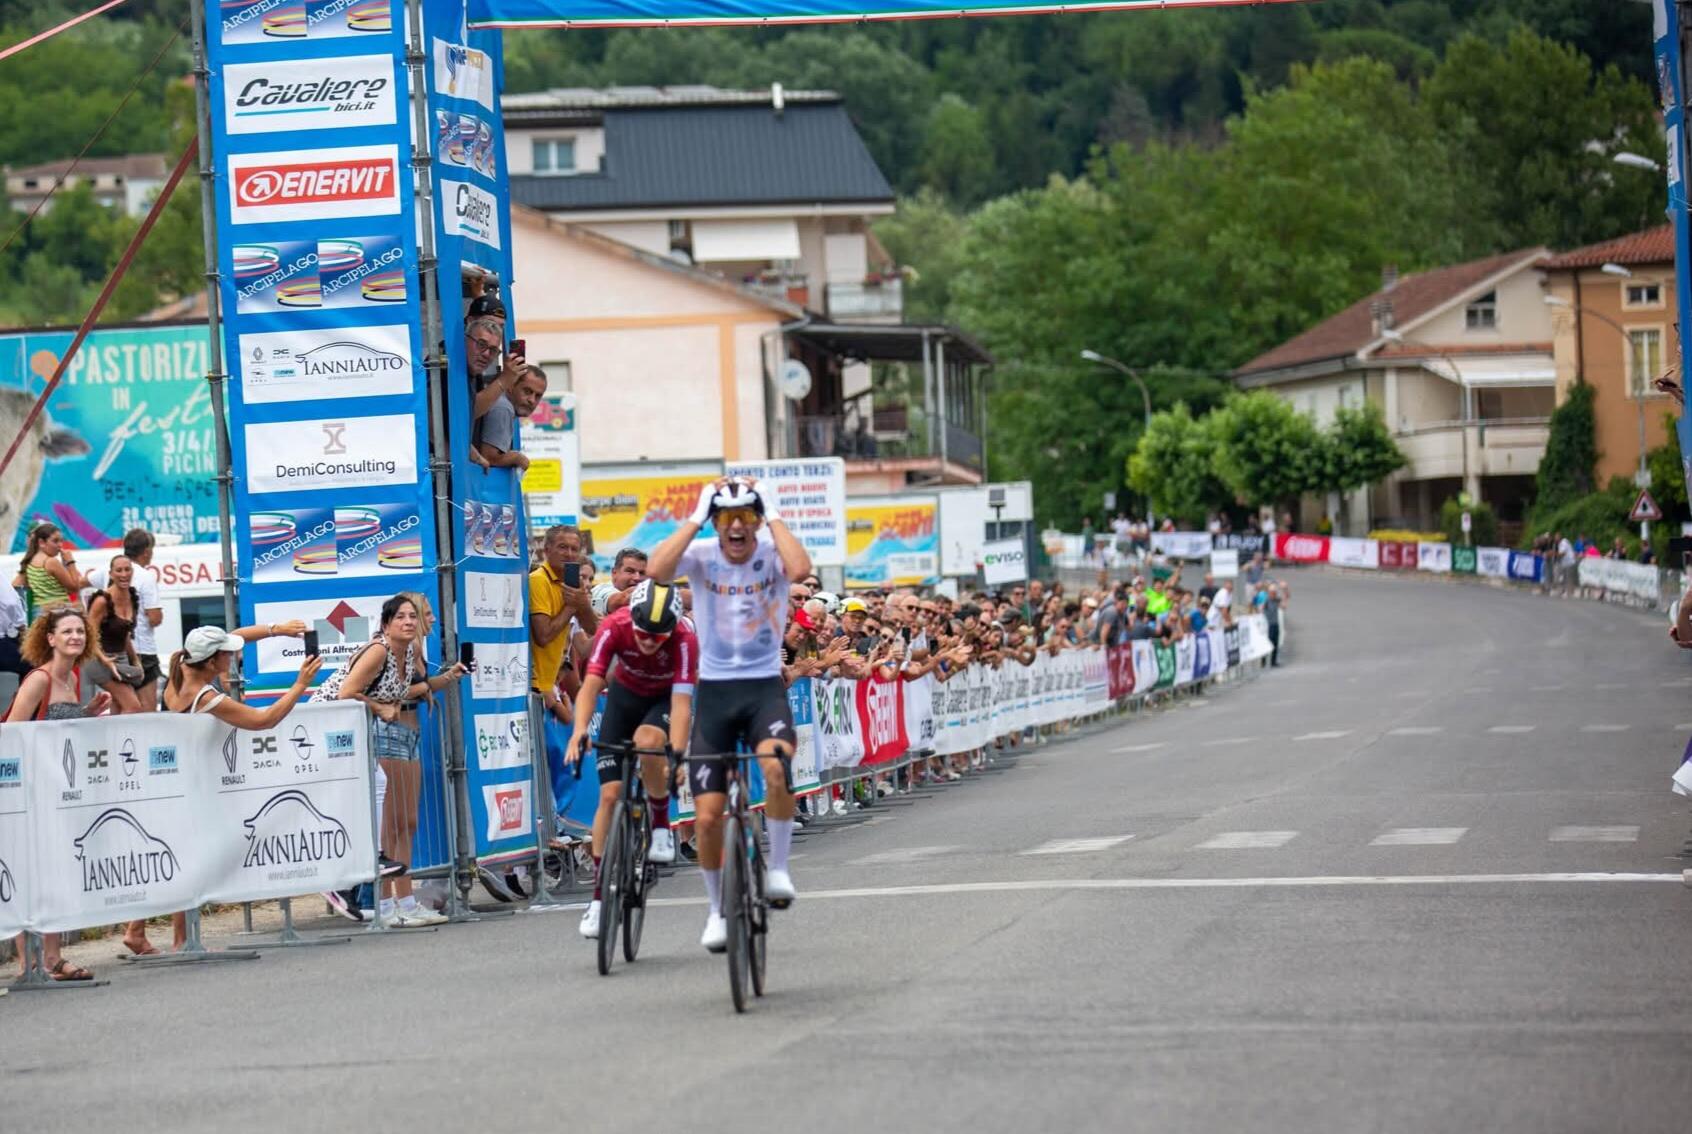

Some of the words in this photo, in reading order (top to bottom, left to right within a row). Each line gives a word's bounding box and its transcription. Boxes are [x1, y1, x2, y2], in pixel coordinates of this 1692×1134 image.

[236, 77, 387, 107] Cavaliere
[334, 101, 376, 112] bici.it
[281, 165, 391, 198] ENERVIT
[237, 253, 318, 301] ARCIPELAGO
[322, 247, 403, 297] ARCIPELAGO
[68, 340, 210, 385] PASTORIZI
[112, 387, 130, 410] IN
[93, 382, 214, 481] fest
[162, 431, 216, 453] 3/4/
[163, 455, 216, 475] PICIN
[276, 459, 395, 478] DemiConsulting
[144, 503, 194, 520] GIUGNO
[151, 517, 194, 534] PASSI
[253, 520, 336, 569] ARCIPELAGO
[338, 514, 419, 563] ARCIPELAGO
[154, 562, 212, 586] OSSA
[222, 775, 246, 786] RENAULT
